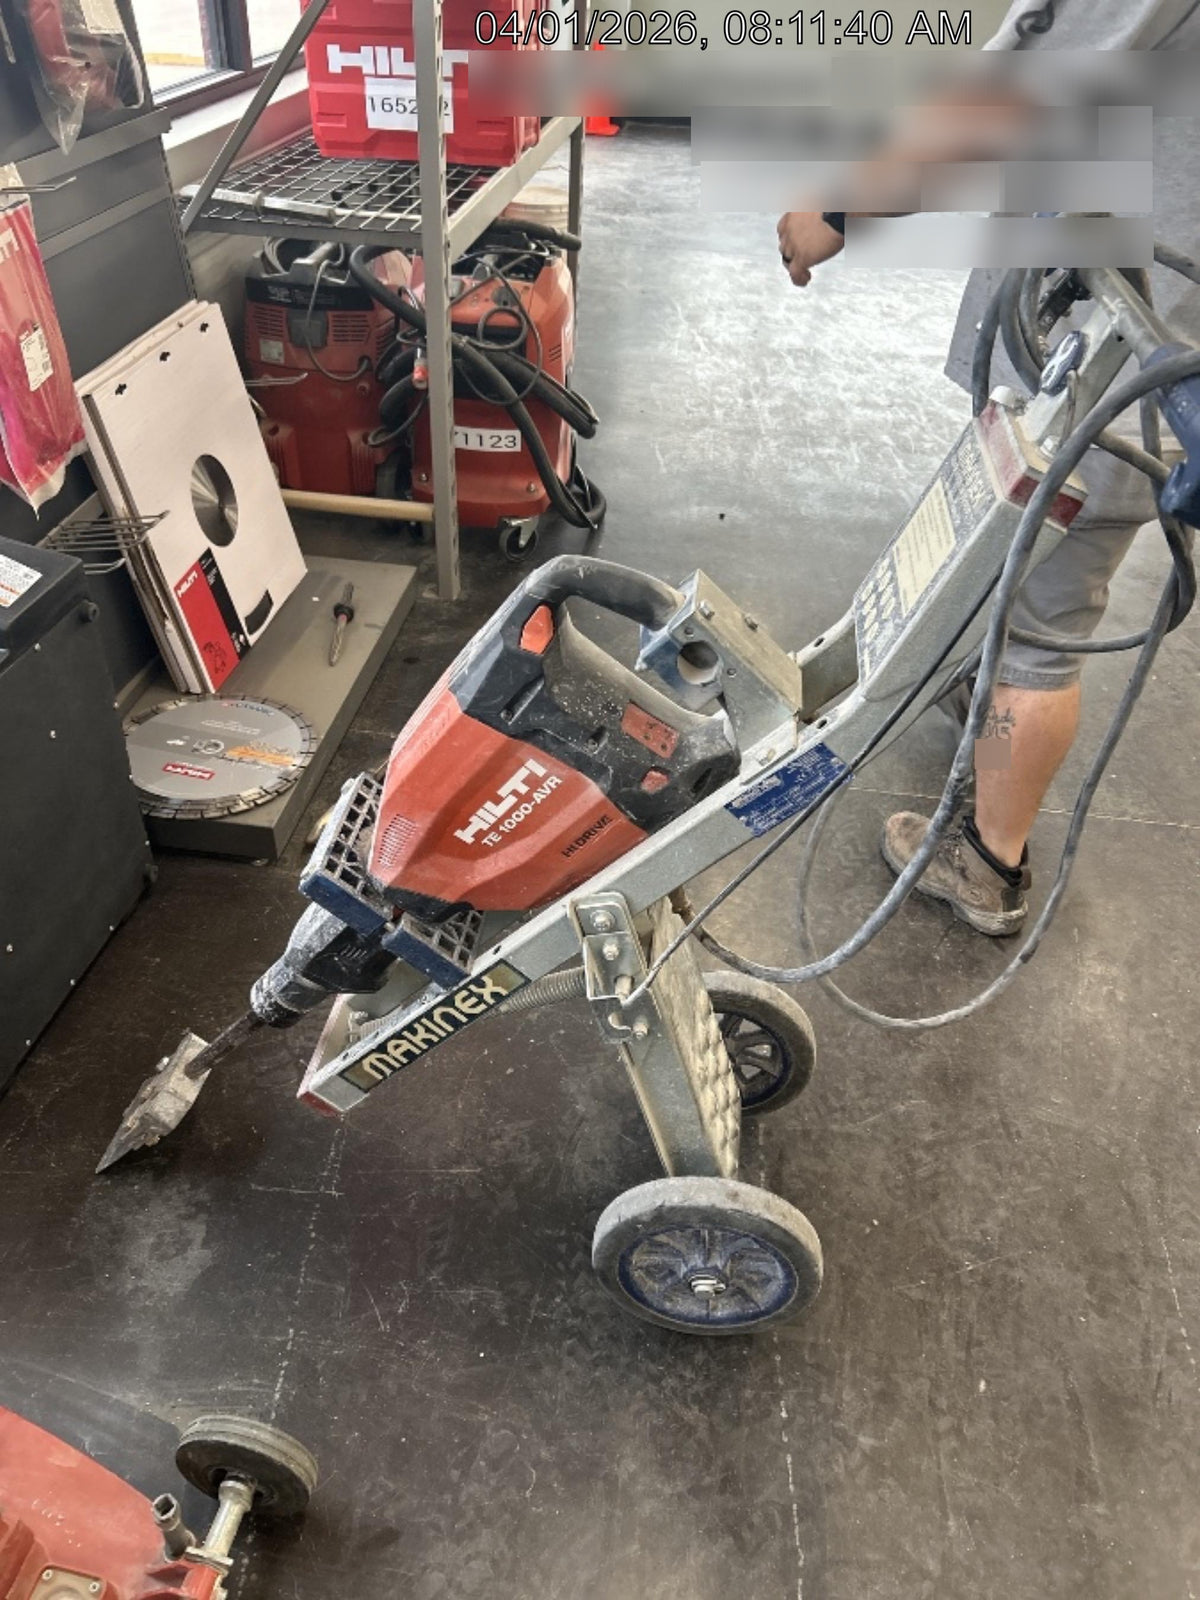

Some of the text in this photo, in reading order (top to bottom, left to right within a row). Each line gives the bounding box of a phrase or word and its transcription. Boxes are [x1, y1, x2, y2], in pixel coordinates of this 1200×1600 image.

[455, 431, 517, 448] 1123
[453, 758, 548, 845] HILTI
[481, 775, 564, 847] TE 1000-AVR
[362, 976, 509, 1080] MAKINEX
